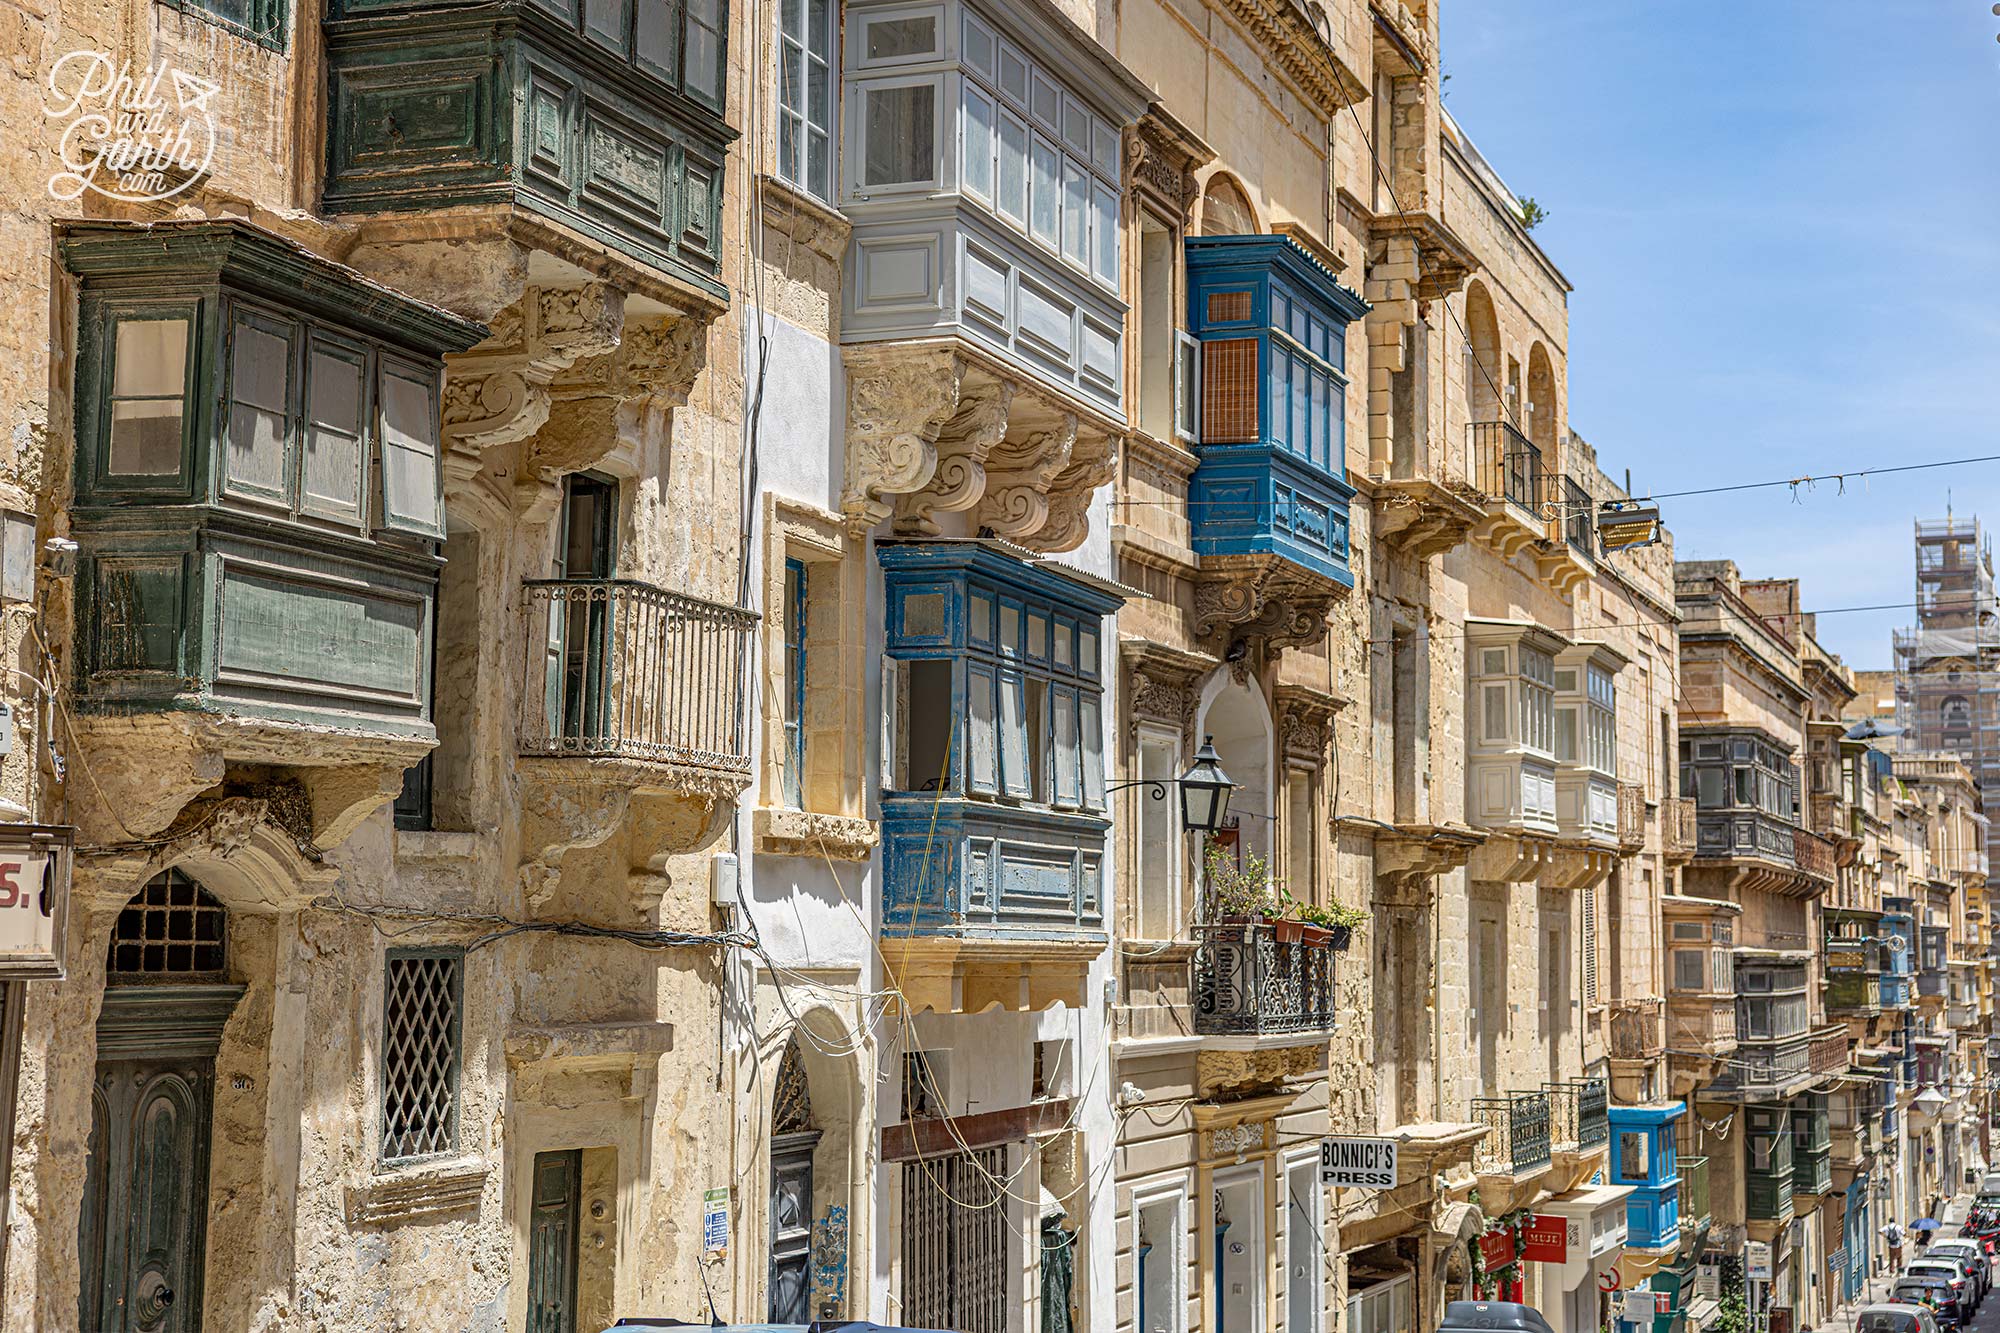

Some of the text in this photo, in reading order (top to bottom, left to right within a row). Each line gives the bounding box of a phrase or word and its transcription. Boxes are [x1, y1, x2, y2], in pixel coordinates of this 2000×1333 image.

[1322, 1142, 1393, 1170] BONNICI'S
[1322, 1171, 1392, 1185] PRESS
[1530, 1233, 1559, 1244] MUJE
